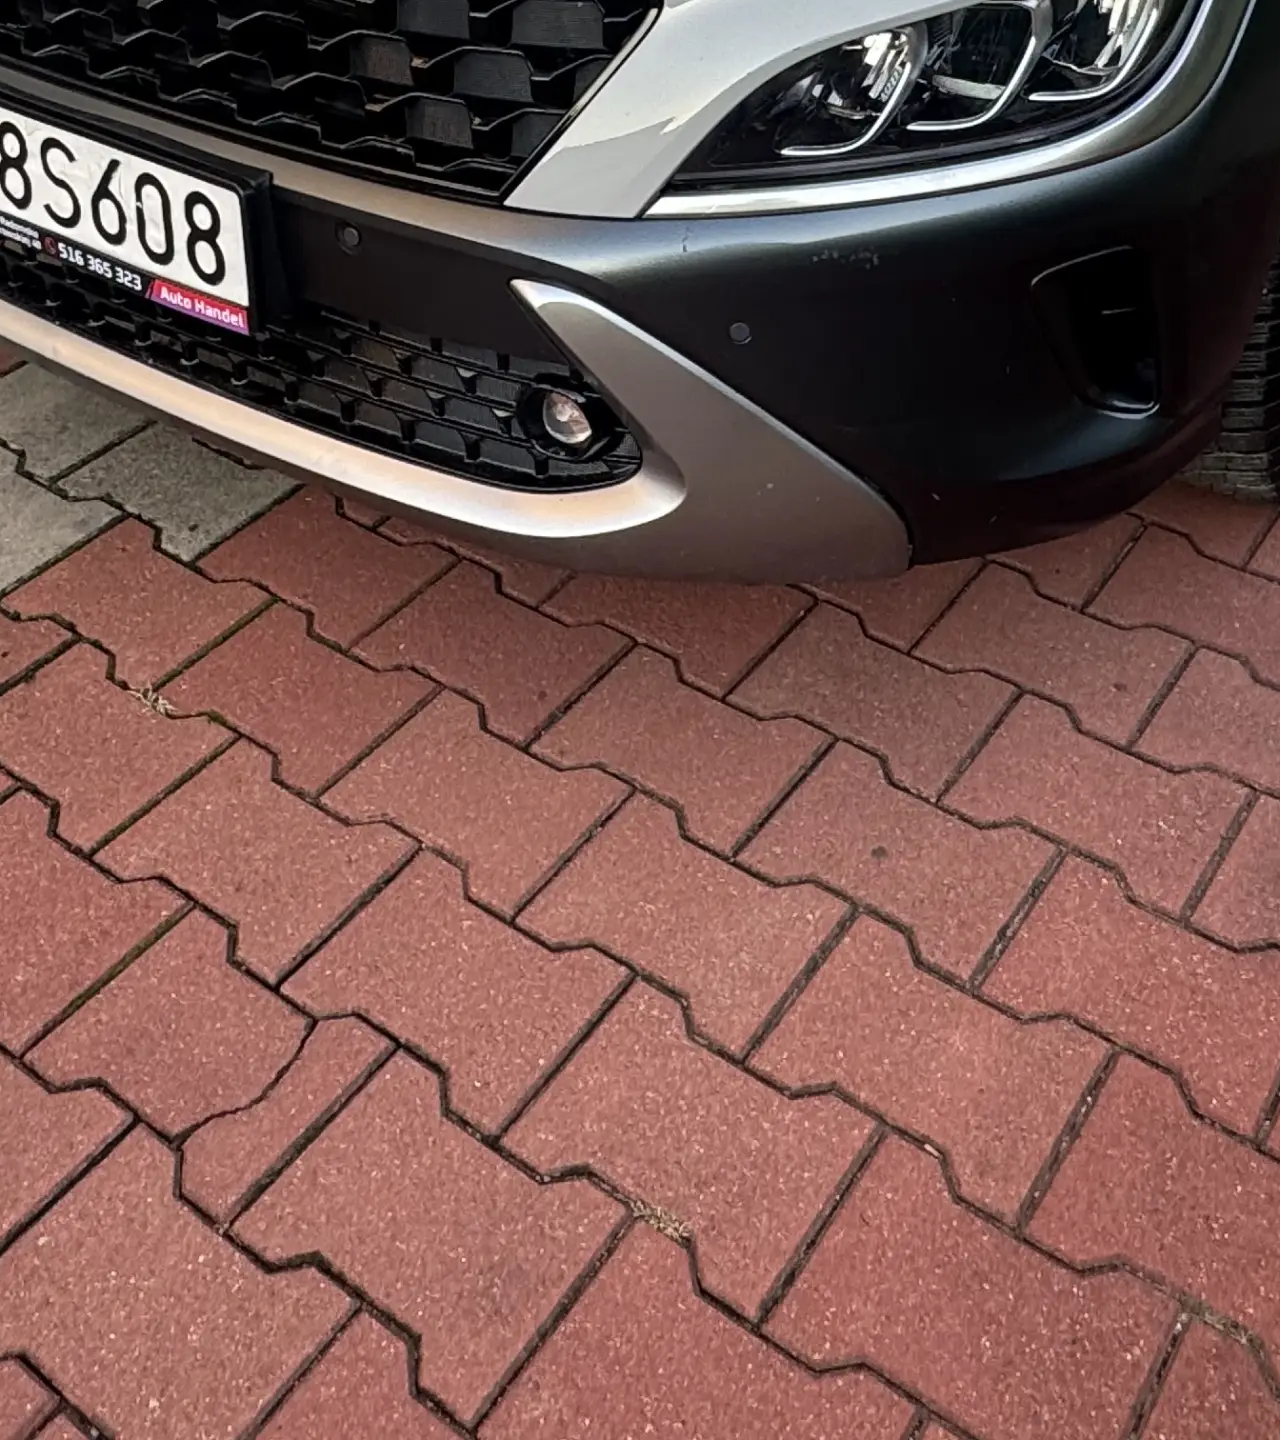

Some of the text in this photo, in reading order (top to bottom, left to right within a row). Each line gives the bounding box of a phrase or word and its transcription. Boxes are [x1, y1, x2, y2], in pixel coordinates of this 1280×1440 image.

[58, 242, 83, 266] 516
[87, 254, 112, 278] 365
[115, 266, 142, 291] 323
[160, 286, 245, 328] Auto Handel
